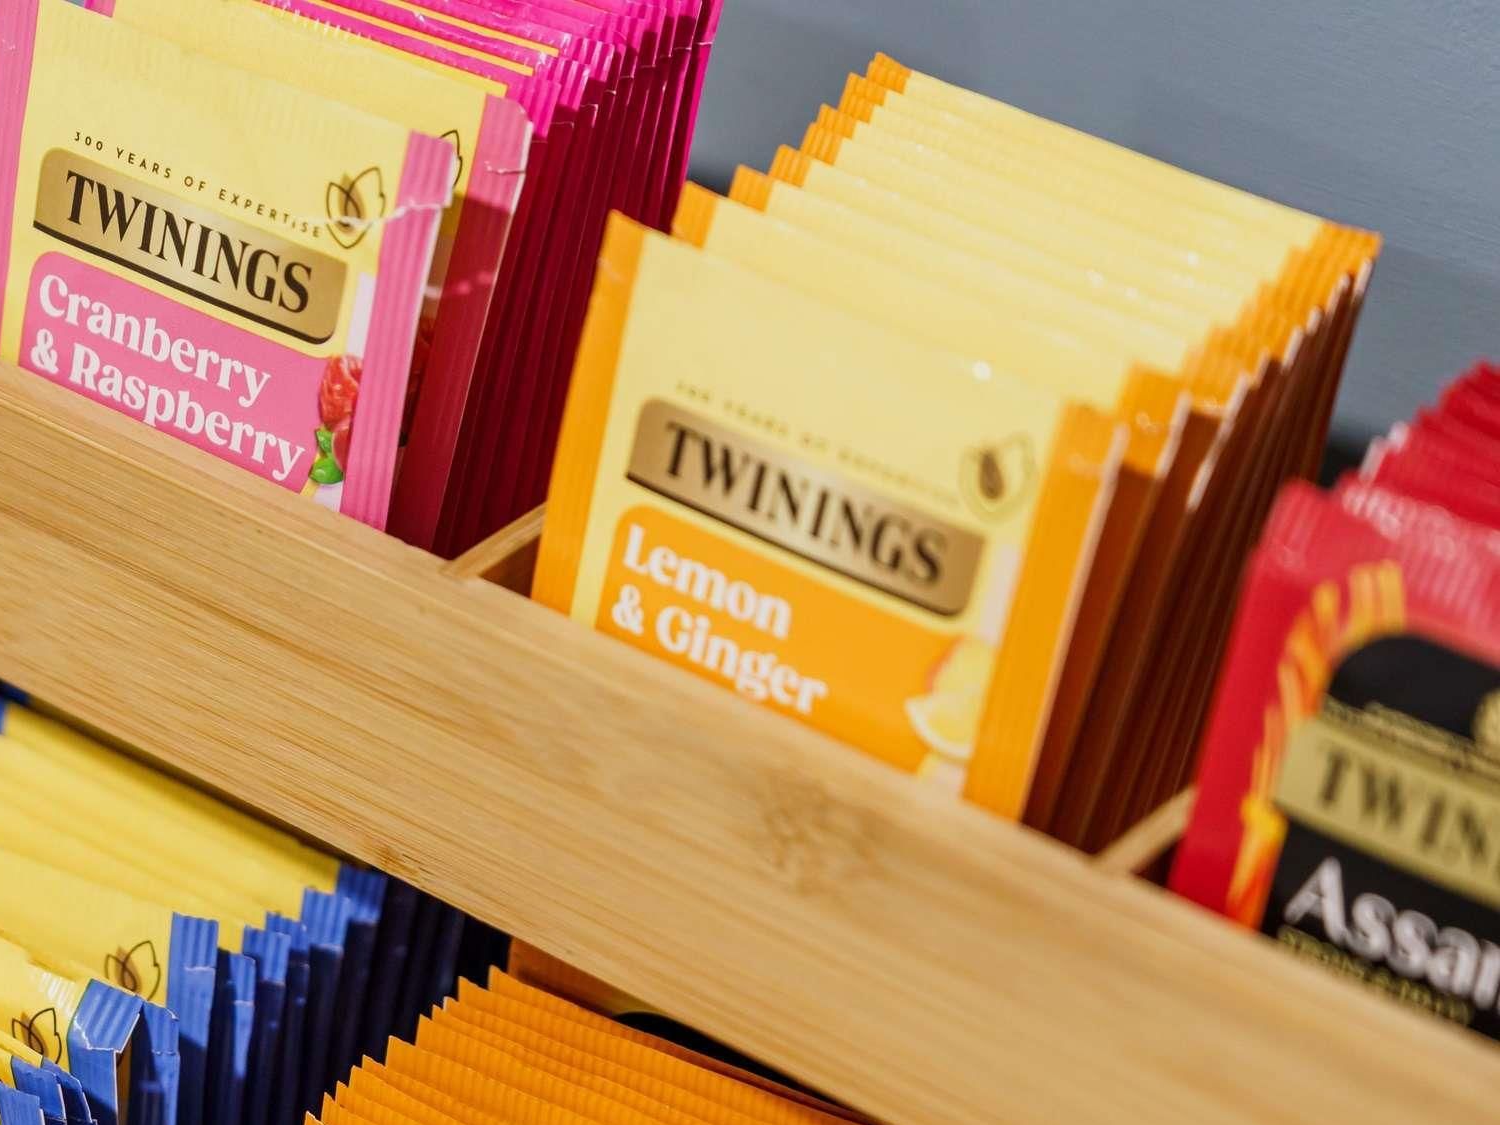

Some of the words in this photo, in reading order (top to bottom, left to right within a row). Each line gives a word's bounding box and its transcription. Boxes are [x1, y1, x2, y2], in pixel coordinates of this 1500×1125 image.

[66, 169, 313, 314] TWININGS
[74, 131, 104, 151] 300
[116, 146, 172, 178] YEARS
[184, 175, 206, 192] OF
[219, 187, 321, 238] EXPERTISE
[30, 328, 60, 375] &
[69, 341, 307, 482] Raspberry
[39, 273, 271, 408] Cranberry
[662, 420, 946, 588] TWININGS
[611, 583, 645, 636] &
[655, 598, 831, 716] Ginger
[622, 523, 792, 640] Lemon
[1316, 740, 1500, 880] TWIN
